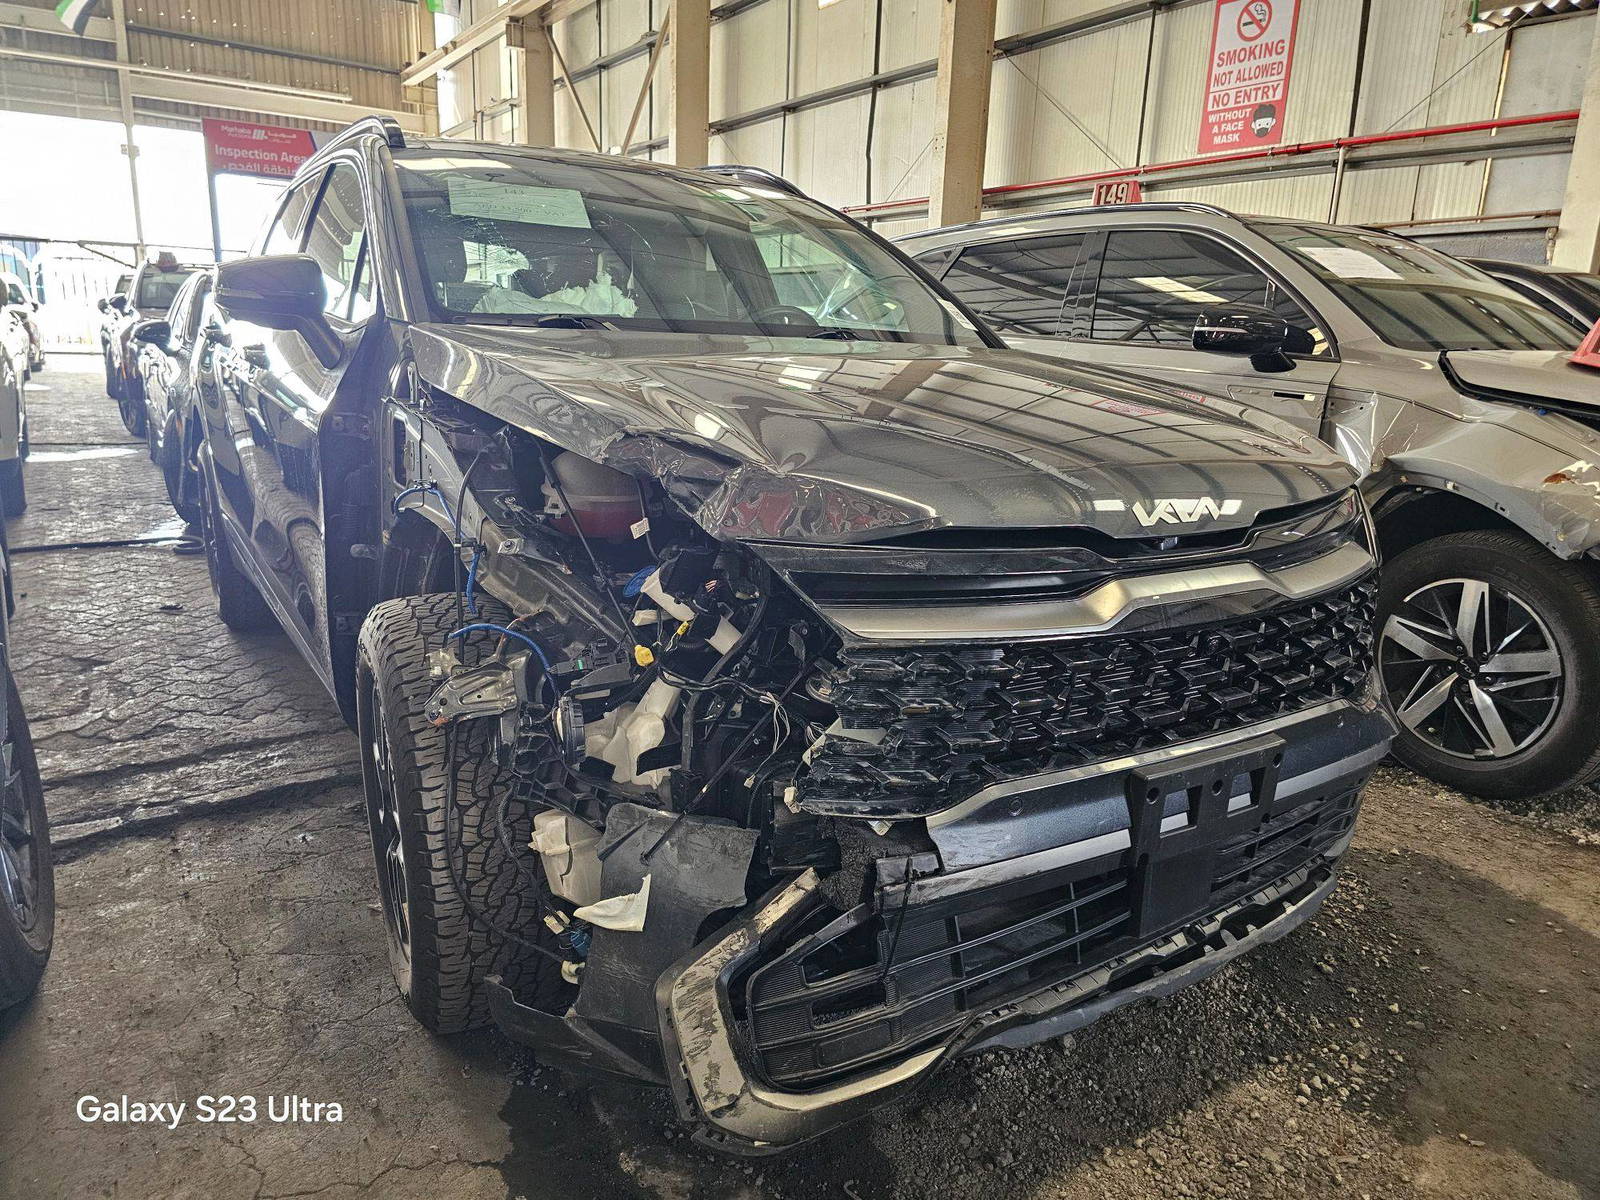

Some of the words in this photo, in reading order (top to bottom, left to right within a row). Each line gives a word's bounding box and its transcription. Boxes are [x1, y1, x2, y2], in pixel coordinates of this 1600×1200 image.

[1217, 39, 1285, 68] SMOKING
[1212, 71, 1233, 88] NOT
[1235, 61, 1284, 83] ALLOWED
[1211, 92, 1231, 109] NO
[1234, 83, 1281, 105] ENTRY
[1208, 108, 1252, 123] WITHOUT
[1212, 125, 1220, 134] A
[1221, 121, 1244, 132] FACE
[1213, 133, 1240, 145] MASK
[215, 144, 278, 161] Inspection
[280, 152, 308, 165] Area
[1099, 183, 1128, 206] 149
